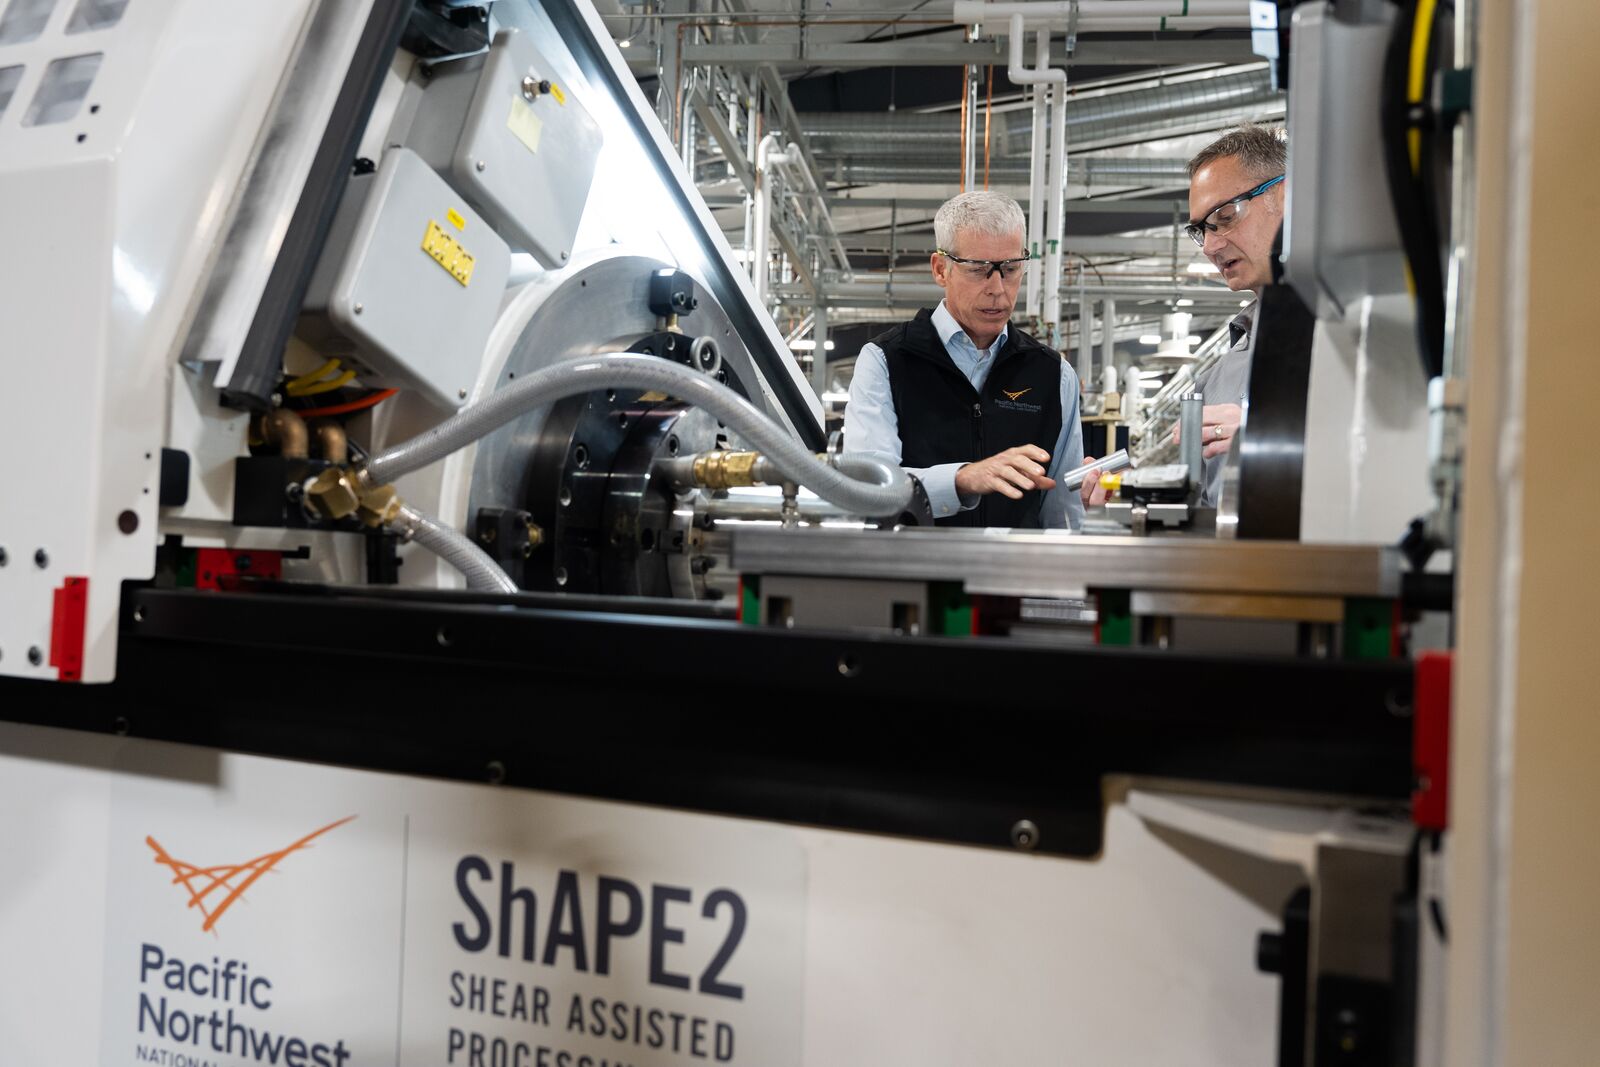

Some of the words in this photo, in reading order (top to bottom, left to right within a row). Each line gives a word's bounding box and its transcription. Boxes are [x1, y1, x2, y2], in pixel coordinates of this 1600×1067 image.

[452, 854, 748, 1001] ShAPE2
[140, 942, 272, 1011] Pacific
[137, 991, 350, 1067] Northwest
[450, 970, 549, 1026] SHEAR
[566, 993, 735, 1063] ASSISTED
[135, 1044, 218, 1067] NATION
